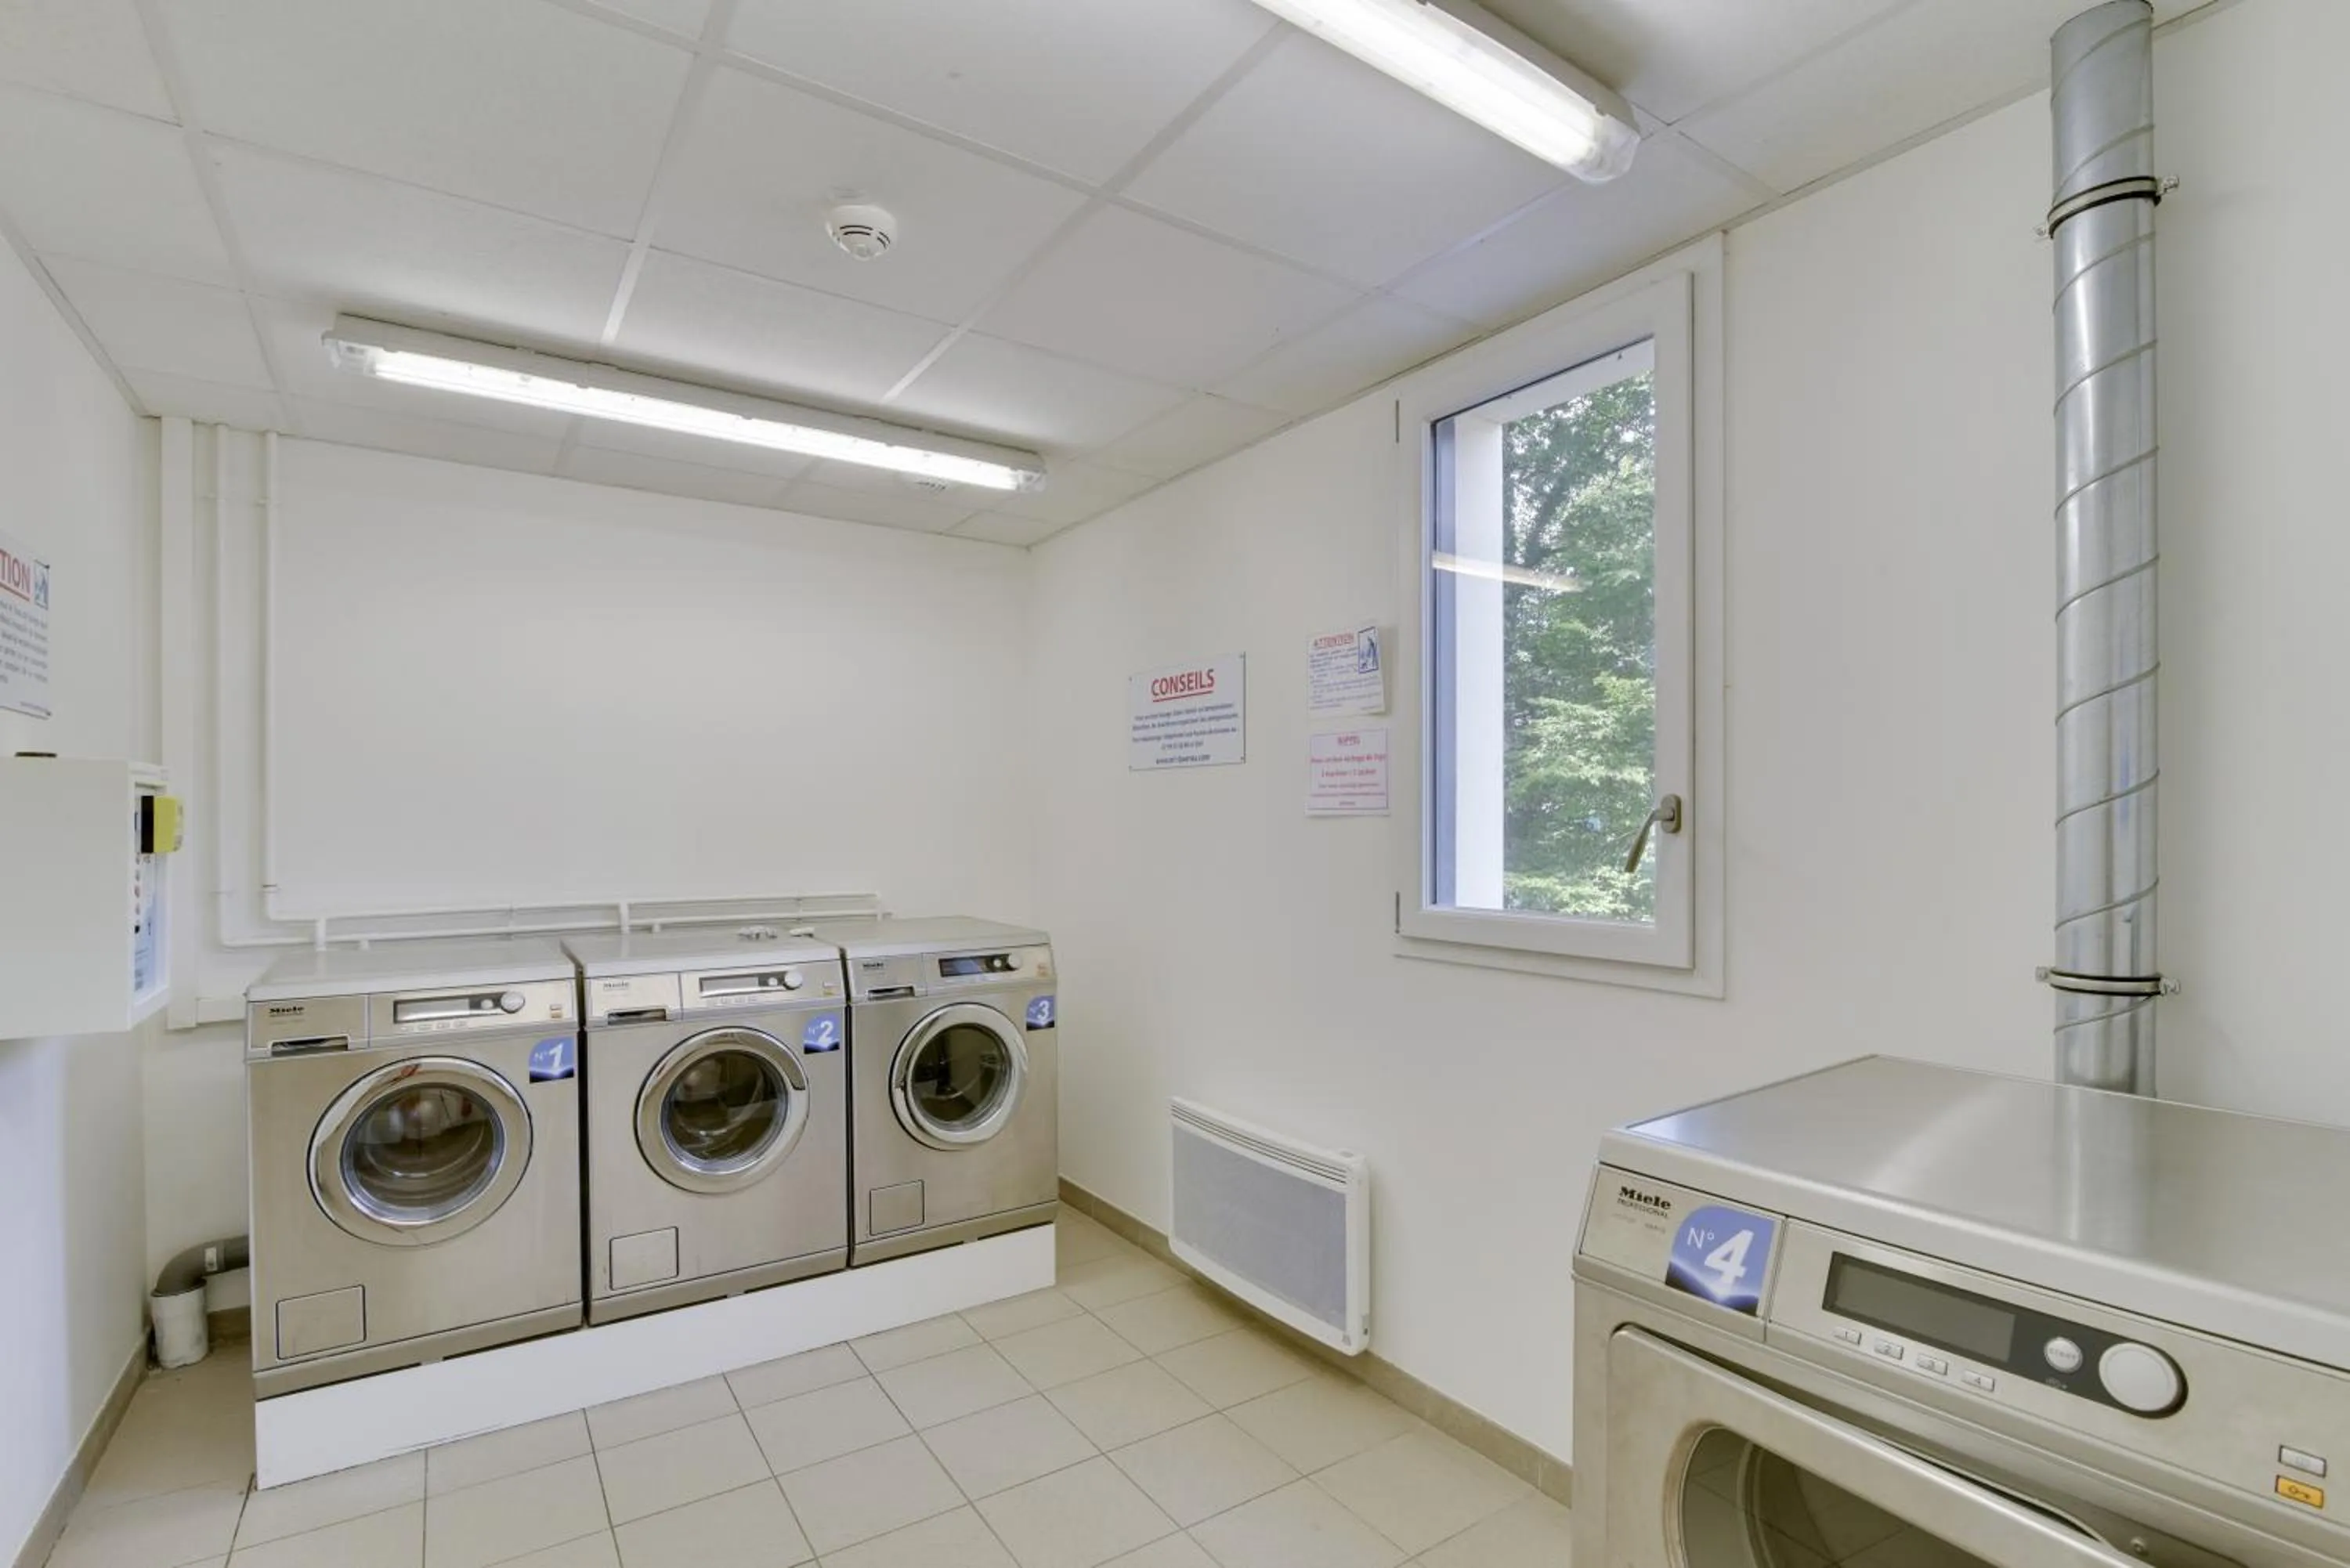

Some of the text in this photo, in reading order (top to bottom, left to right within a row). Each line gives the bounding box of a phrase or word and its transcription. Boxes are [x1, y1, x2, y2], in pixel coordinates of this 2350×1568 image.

[1151, 668, 1215, 696] CONSEILS
[1036, 1000, 1050, 1021] 3
[817, 1020, 833, 1046] 2
[548, 1042, 564, 1075] 1
[1618, 1186, 1671, 1210] Miele
[1687, 1227, 1755, 1297] N° 4
